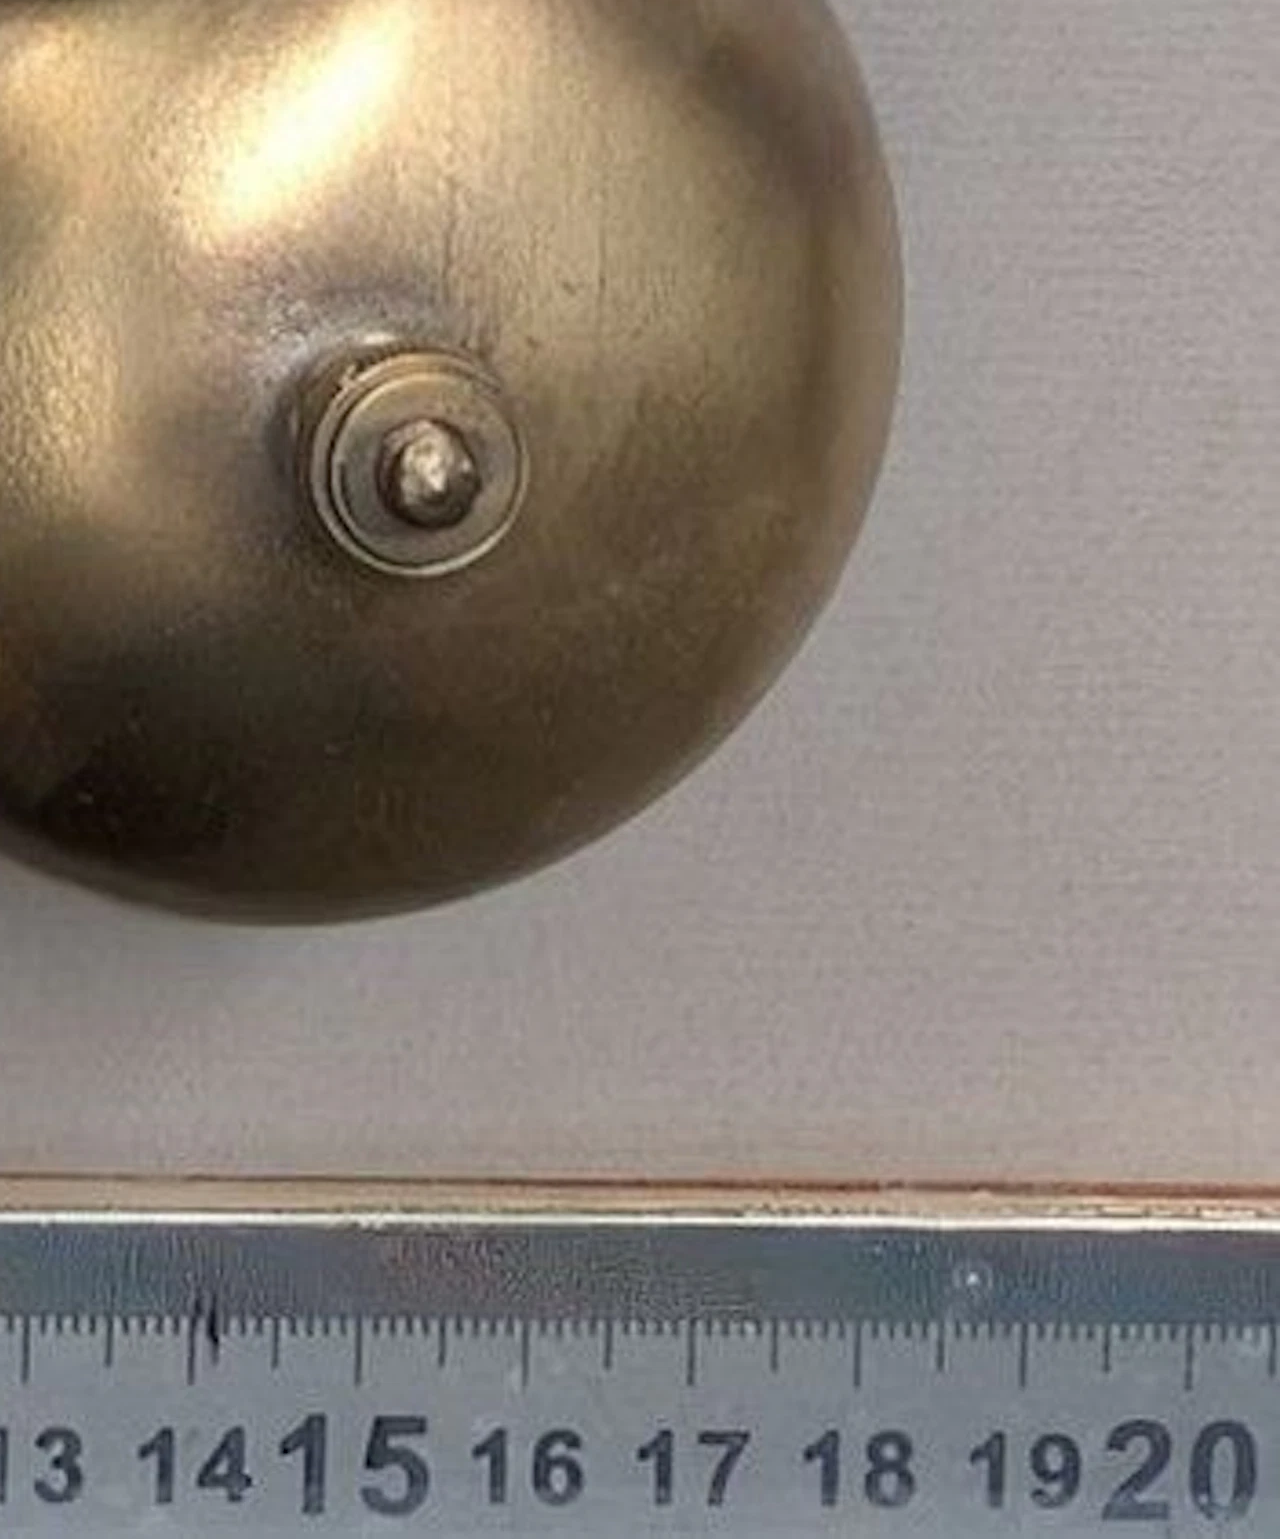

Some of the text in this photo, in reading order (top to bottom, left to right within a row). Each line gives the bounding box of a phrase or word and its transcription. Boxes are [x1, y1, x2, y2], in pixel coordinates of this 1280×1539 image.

[138, 1428, 252, 1503] 14
[280, 1414, 429, 1515] 15
[472, 1429, 583, 1505] 16
[637, 1430, 751, 1505] 17
[804, 1431, 915, 1507] 18
[970, 1432, 1080, 1508] 19
[1106, 1419, 1257, 1519] 20
